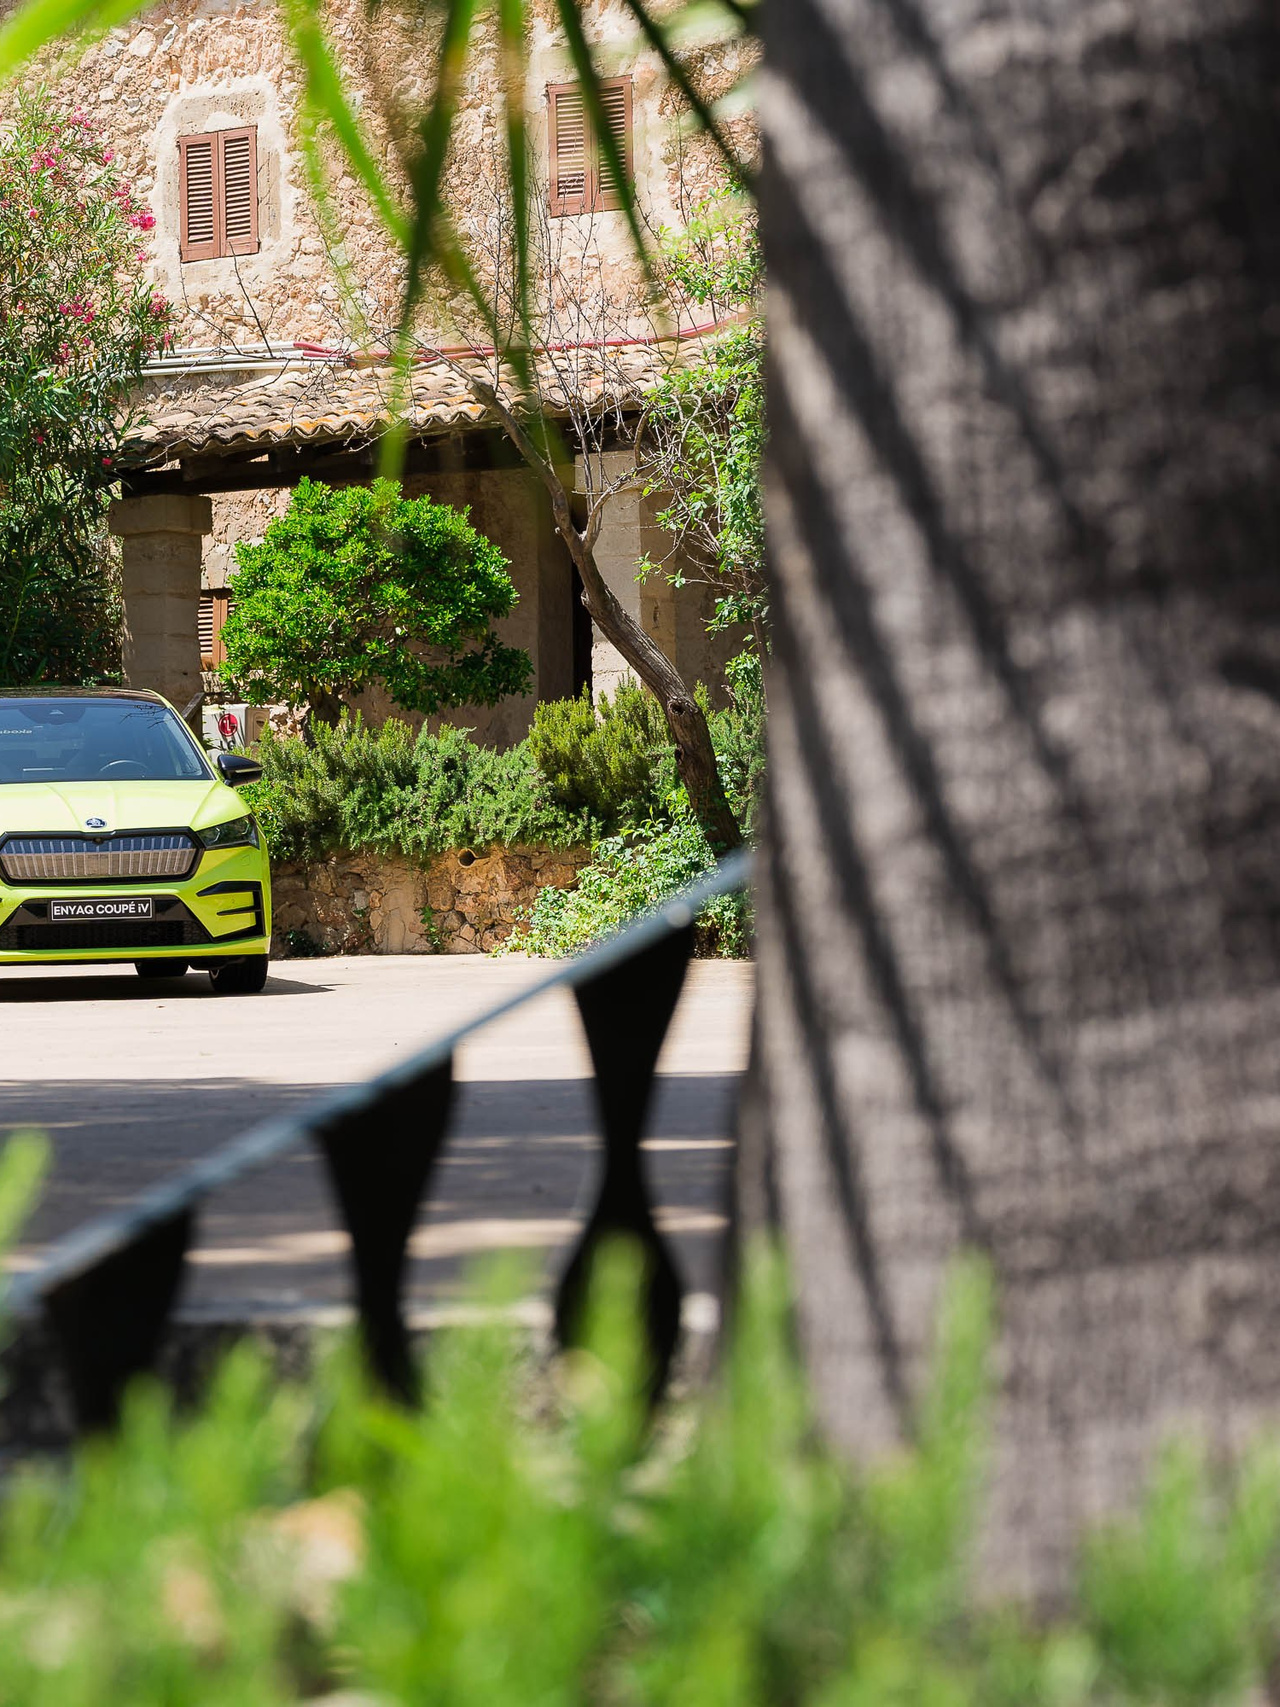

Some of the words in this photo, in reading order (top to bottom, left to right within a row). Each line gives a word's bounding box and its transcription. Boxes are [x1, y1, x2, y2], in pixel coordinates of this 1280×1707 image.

[53, 904, 94, 916] ENYAQ
[96, 901, 136, 914] COUPÉ
[138, 903, 149, 913] iV
